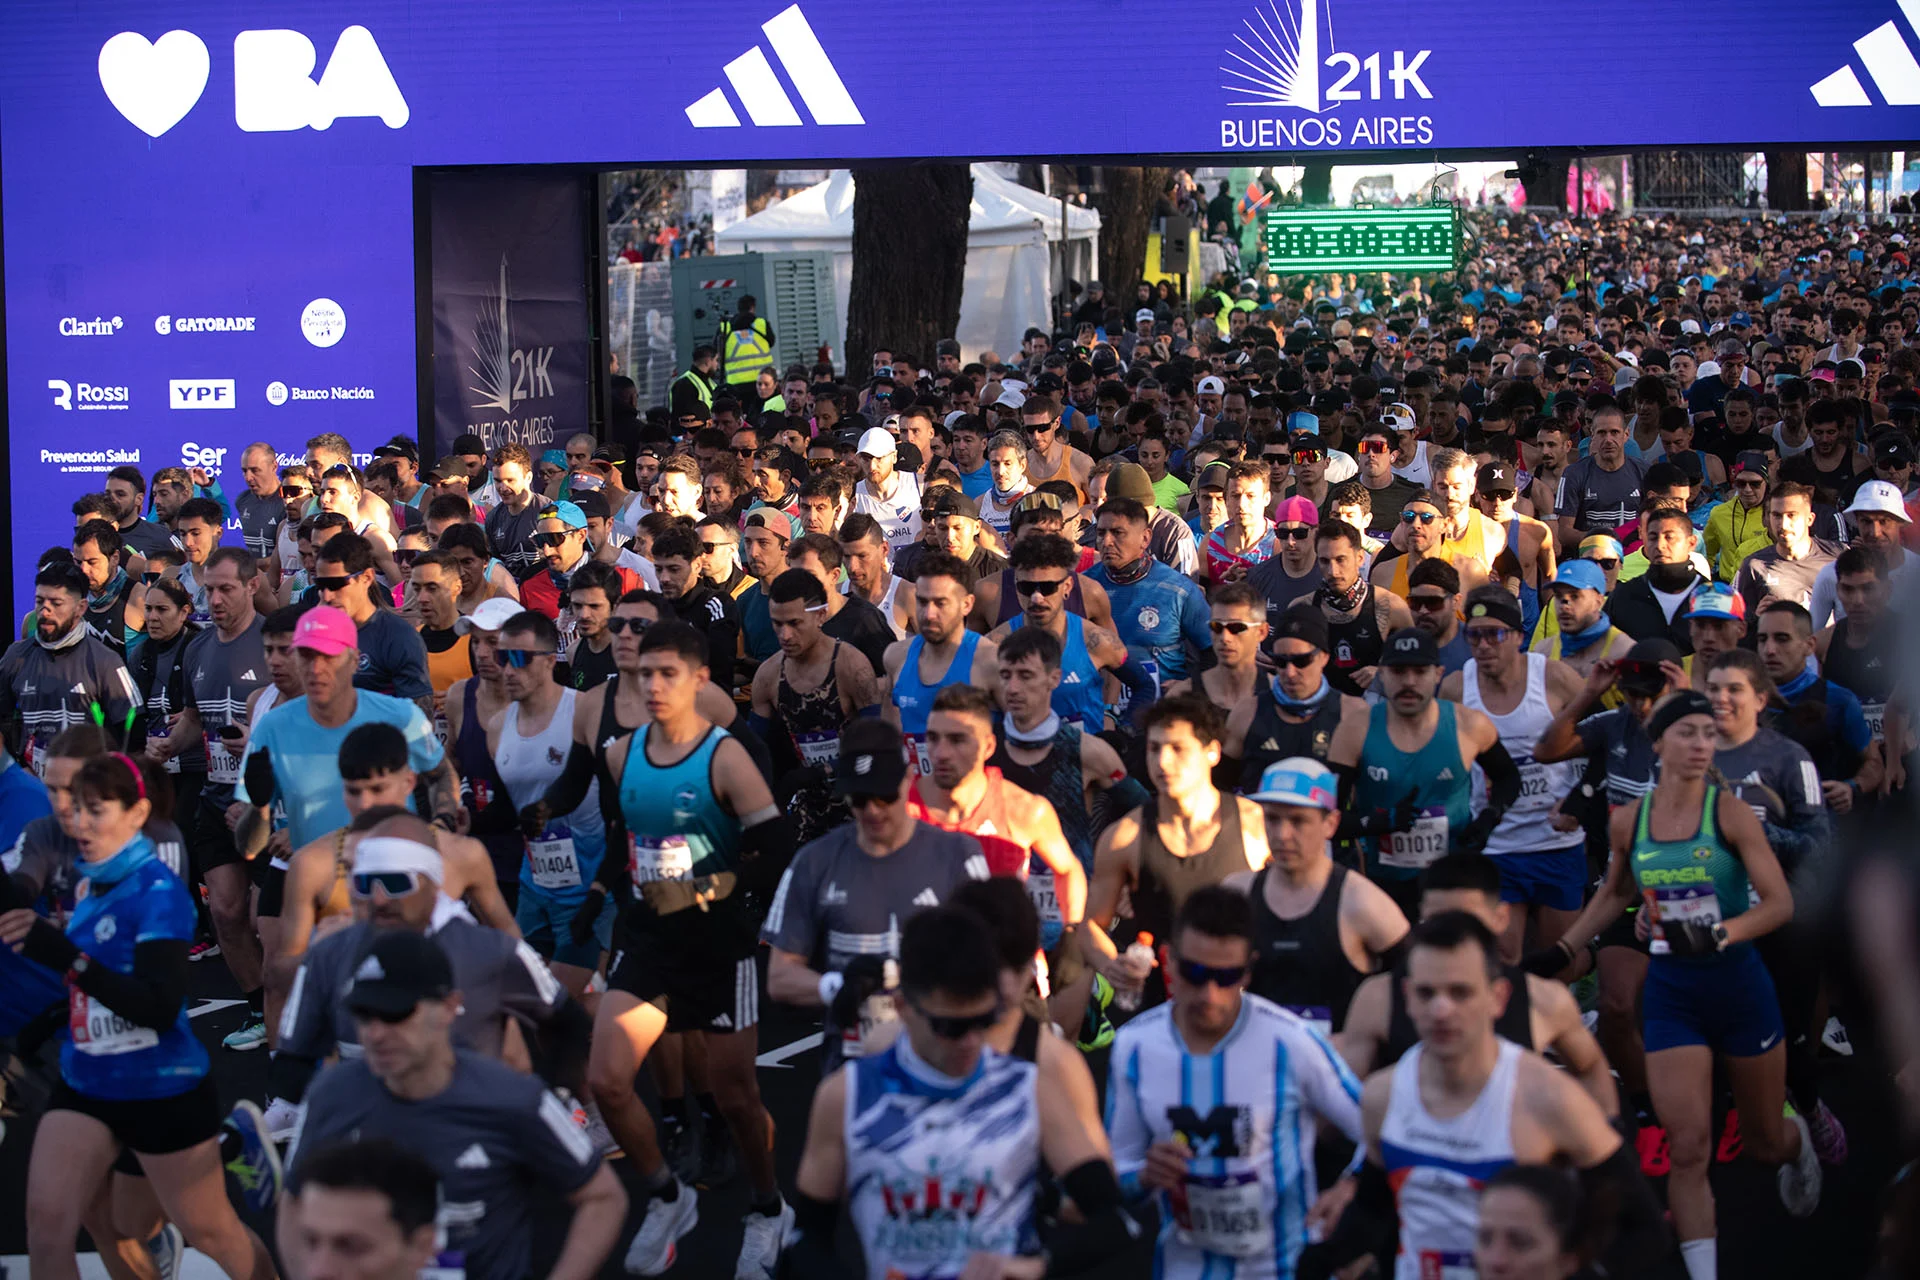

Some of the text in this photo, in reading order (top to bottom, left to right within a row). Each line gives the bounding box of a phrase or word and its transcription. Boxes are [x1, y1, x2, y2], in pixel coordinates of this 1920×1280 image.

[233, 25, 410, 132] BA
[1324, 50, 1434, 101] 21K
[1221, 116, 1434, 147] BUENOS AIRES
[59, 317, 114, 336] Clarín
[175, 317, 256, 332] GATORADE
[511, 346, 554, 400] 21K
[178, 387, 227, 401] YPF
[292, 386, 375, 400] Banco Nación
[521, 415, 554, 446] AIRES
[106, 449, 140, 463] Salud
[182, 442, 227, 467] Ser
[1394, 833, 1443, 853] 01012
